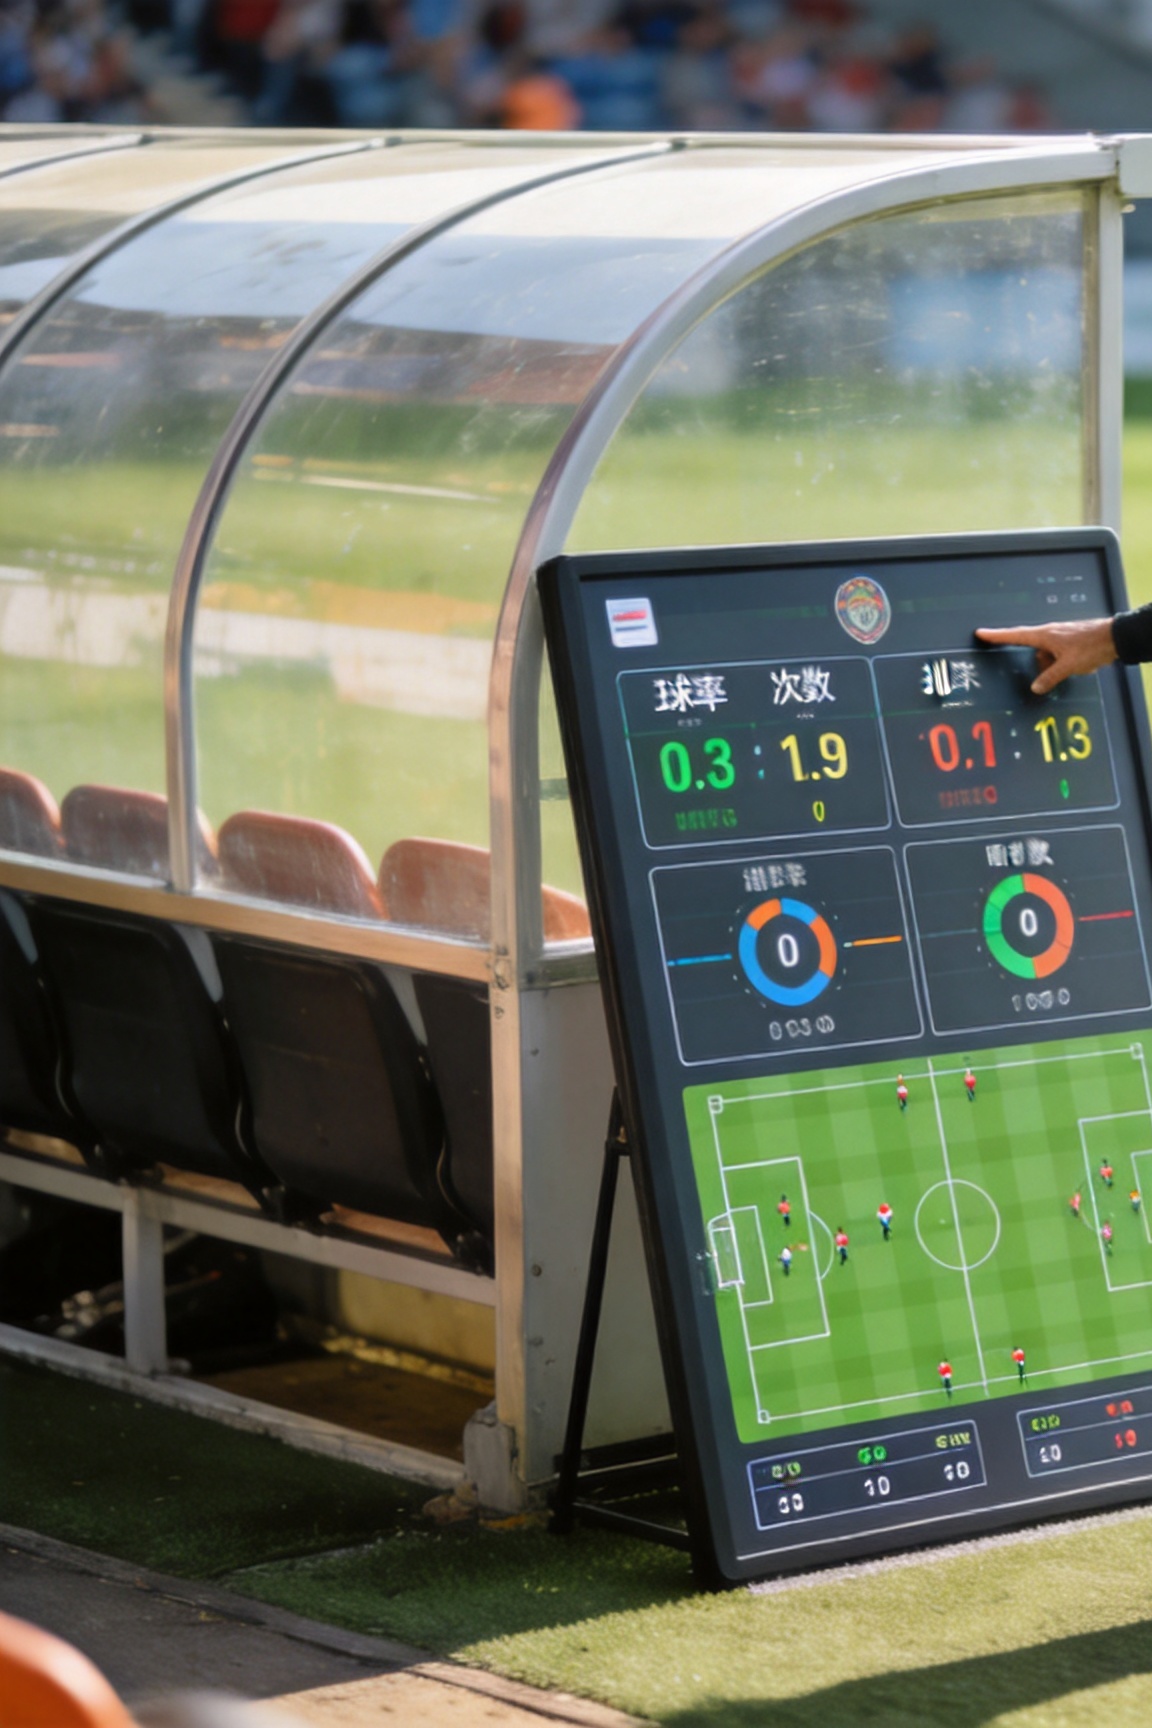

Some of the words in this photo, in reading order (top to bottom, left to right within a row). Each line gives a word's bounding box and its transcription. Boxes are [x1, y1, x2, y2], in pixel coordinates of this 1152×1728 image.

[770, 665, 836, 705] 次数
[659, 737, 736, 792] 0.3
[780, 732, 848, 782] 1.9
[929, 721, 997, 772] 0.1
[1020, 908, 1038, 937] 0
[777, 933, 799, 967] 0
